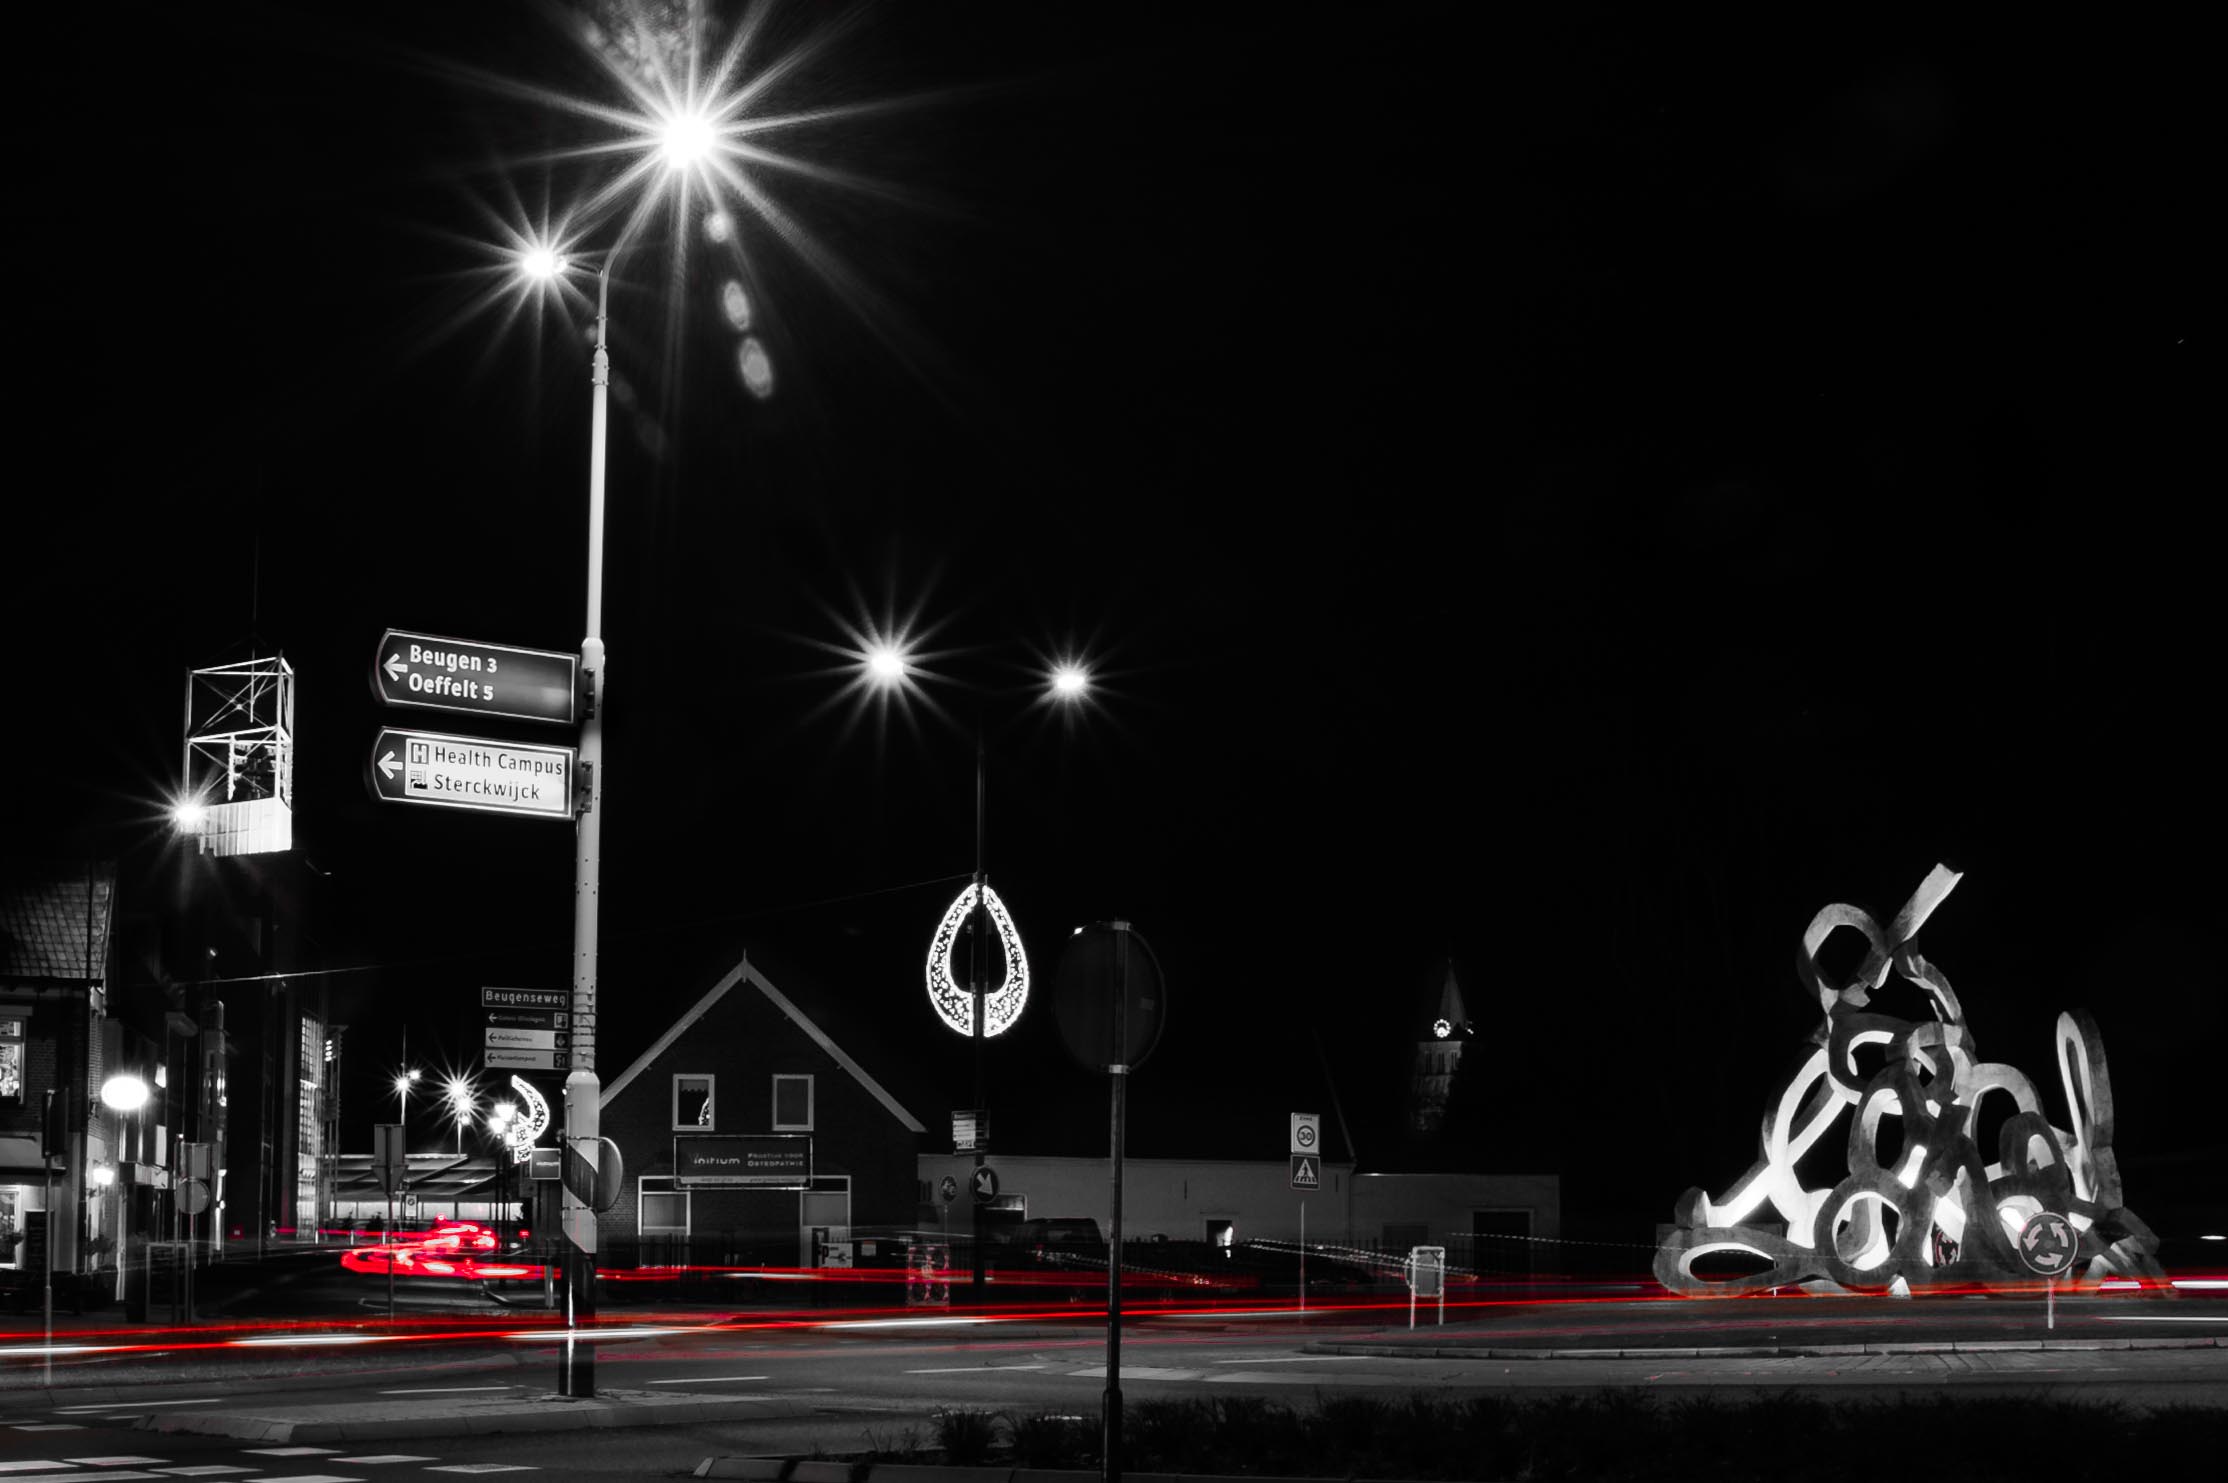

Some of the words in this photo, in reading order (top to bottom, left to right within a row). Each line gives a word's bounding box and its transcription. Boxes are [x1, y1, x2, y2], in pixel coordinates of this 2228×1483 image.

[409, 644, 482, 673] Beugen
[487, 658, 497, 673] 3
[408, 673, 478, 699] Oeffelt
[483, 685, 494, 701] 5
[435, 746, 492, 768] Health
[498, 753, 563, 776] Campus
[434, 773, 541, 802] Sterckwijck
[485, 990, 566, 1007] Beugenseweg
[1300, 1131, 1313, 1141] 30
